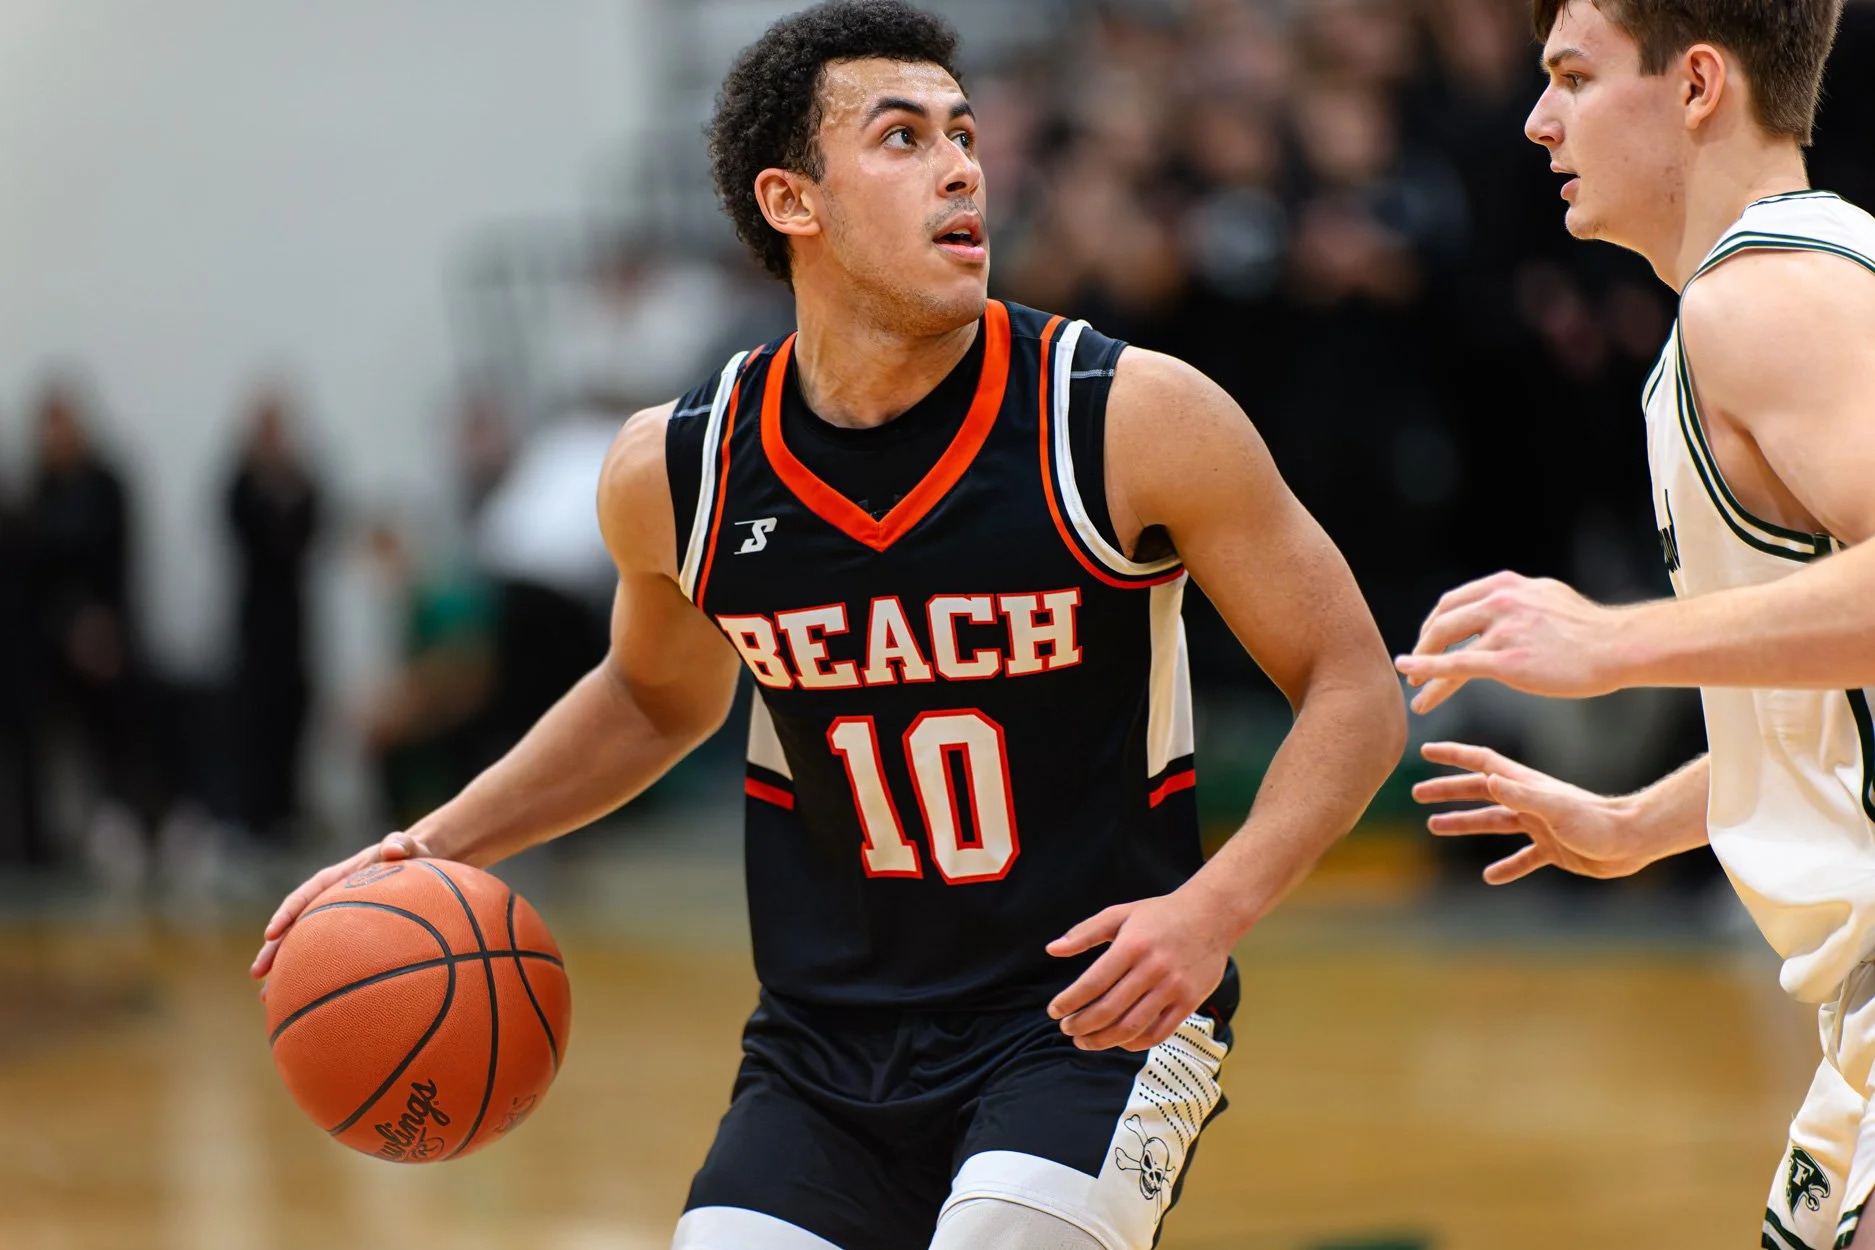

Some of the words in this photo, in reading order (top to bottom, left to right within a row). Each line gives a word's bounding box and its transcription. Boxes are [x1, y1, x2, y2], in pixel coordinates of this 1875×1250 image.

[715, 587, 1082, 690] BEACH
[826, 707, 1020, 885] 10
[375, 1078, 451, 1160] wlings
